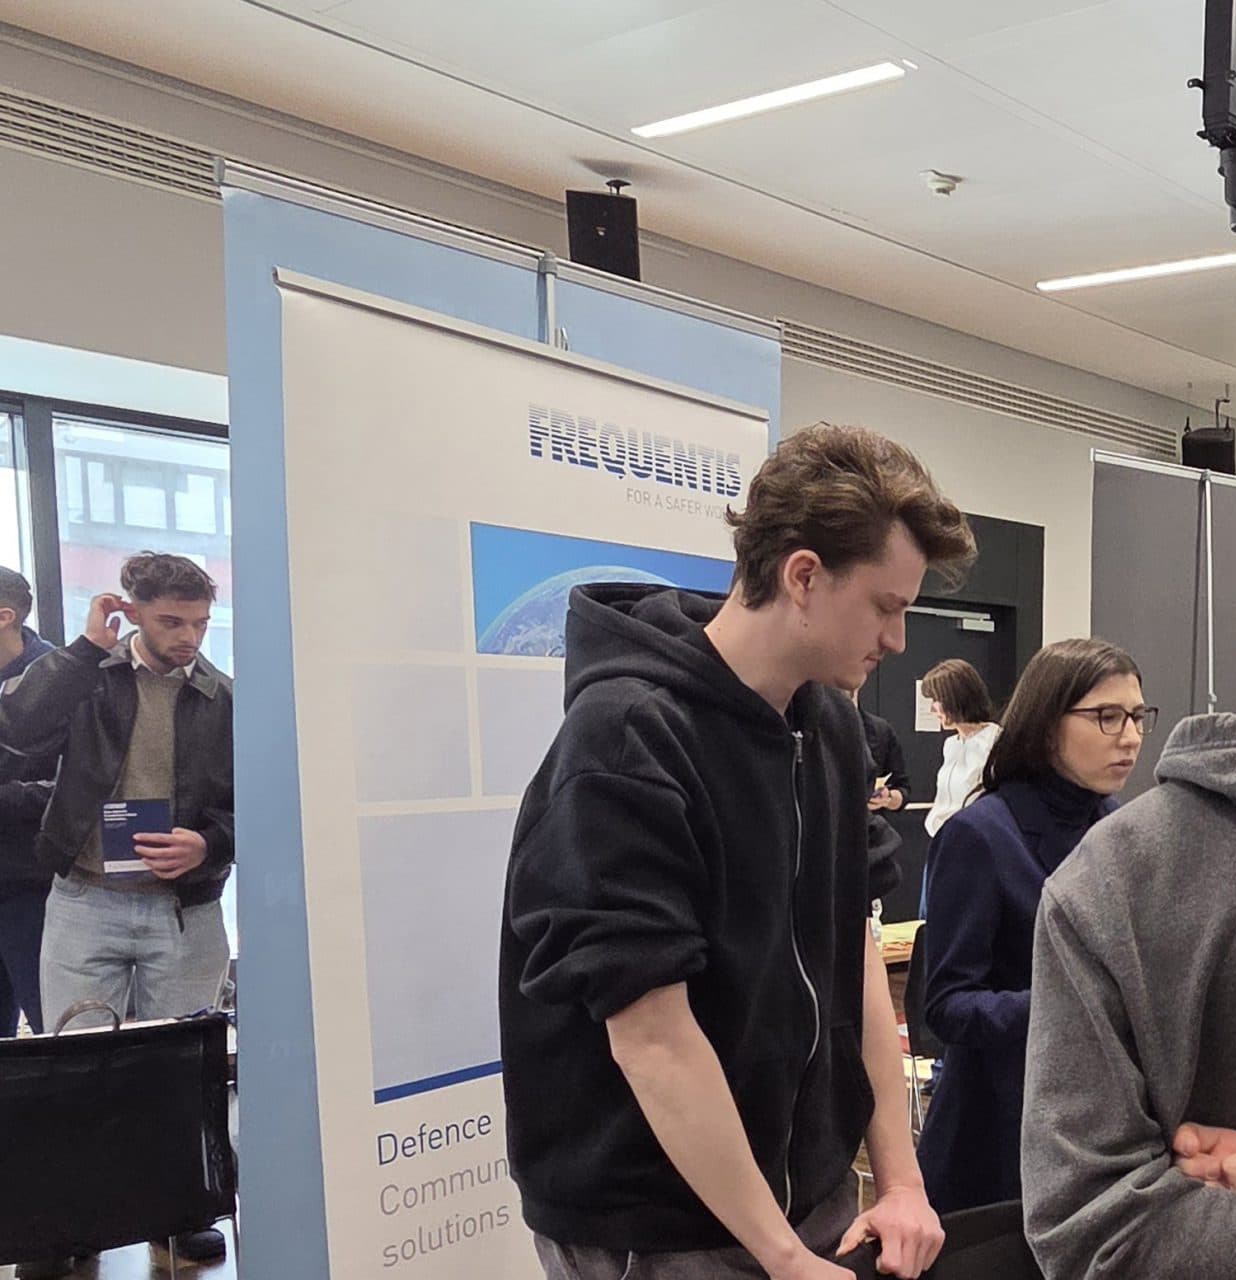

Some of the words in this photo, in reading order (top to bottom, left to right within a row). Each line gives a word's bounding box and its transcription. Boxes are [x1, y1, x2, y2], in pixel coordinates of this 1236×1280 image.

[528, 403, 742, 498] FREQUENTIS
[626, 487, 651, 507] FOR
[654, 495, 663, 508] A
[666, 496, 701, 515] SAFER
[376, 1113, 492, 1166] Defence
[379, 1157, 508, 1216] Commun
[383, 1204, 511, 1268] solutions
